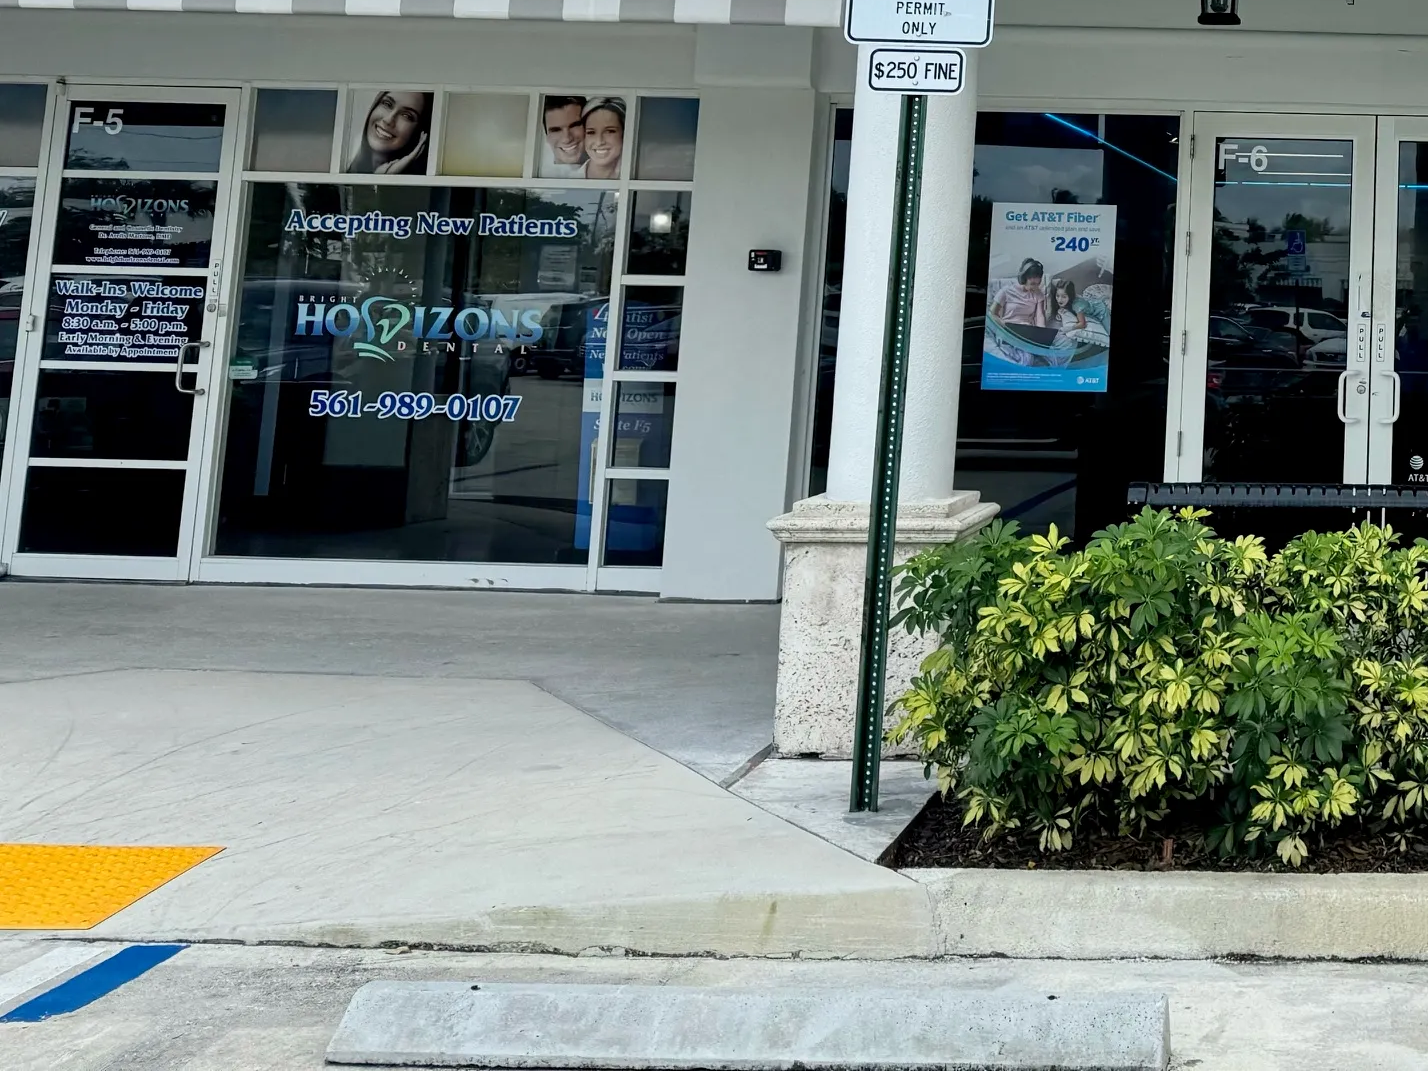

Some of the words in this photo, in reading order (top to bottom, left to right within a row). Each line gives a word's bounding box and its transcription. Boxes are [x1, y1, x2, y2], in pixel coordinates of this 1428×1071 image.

[896, 1, 946, 16] PERMIT
[902, 21, 937, 36] ONLY
[874, 61, 918, 81] $250
[924, 62, 958, 81] FINE
[72, 106, 124, 135] F-5
[1218, 144, 1269, 172] F-6
[285, 209, 412, 238] Accepting
[416, 211, 474, 237] New
[478, 213, 578, 238] Patients
[1005, 211, 1028, 222] Get
[1031, 212, 1065, 223] AT&T
[1067, 212, 1098, 224] Fiber
[212, 262, 220, 294] PULL
[56, 280, 127, 297] Walk-Ins
[131, 282, 204, 298] Welcome
[298, 295, 359, 304] BRIGHT
[64, 299, 128, 318] Monday
[142, 300, 189, 319] Friday
[62, 317, 90, 330] 8:30
[91, 319, 119, 330] a.m.
[130, 319, 158, 331] 5:00
[159, 321, 188, 333] p.m.
[58, 332, 87, 345] Early
[87, 332, 136, 346] Morning
[134, 335, 143, 345] &
[146, 334, 188, 347] Evening
[397, 340, 527, 355] DENTAL
[65, 345, 108, 356] Available
[108, 345, 121, 357] by
[120, 346, 179, 358] Appointment
[309, 390, 523, 422] 561-989-0107
